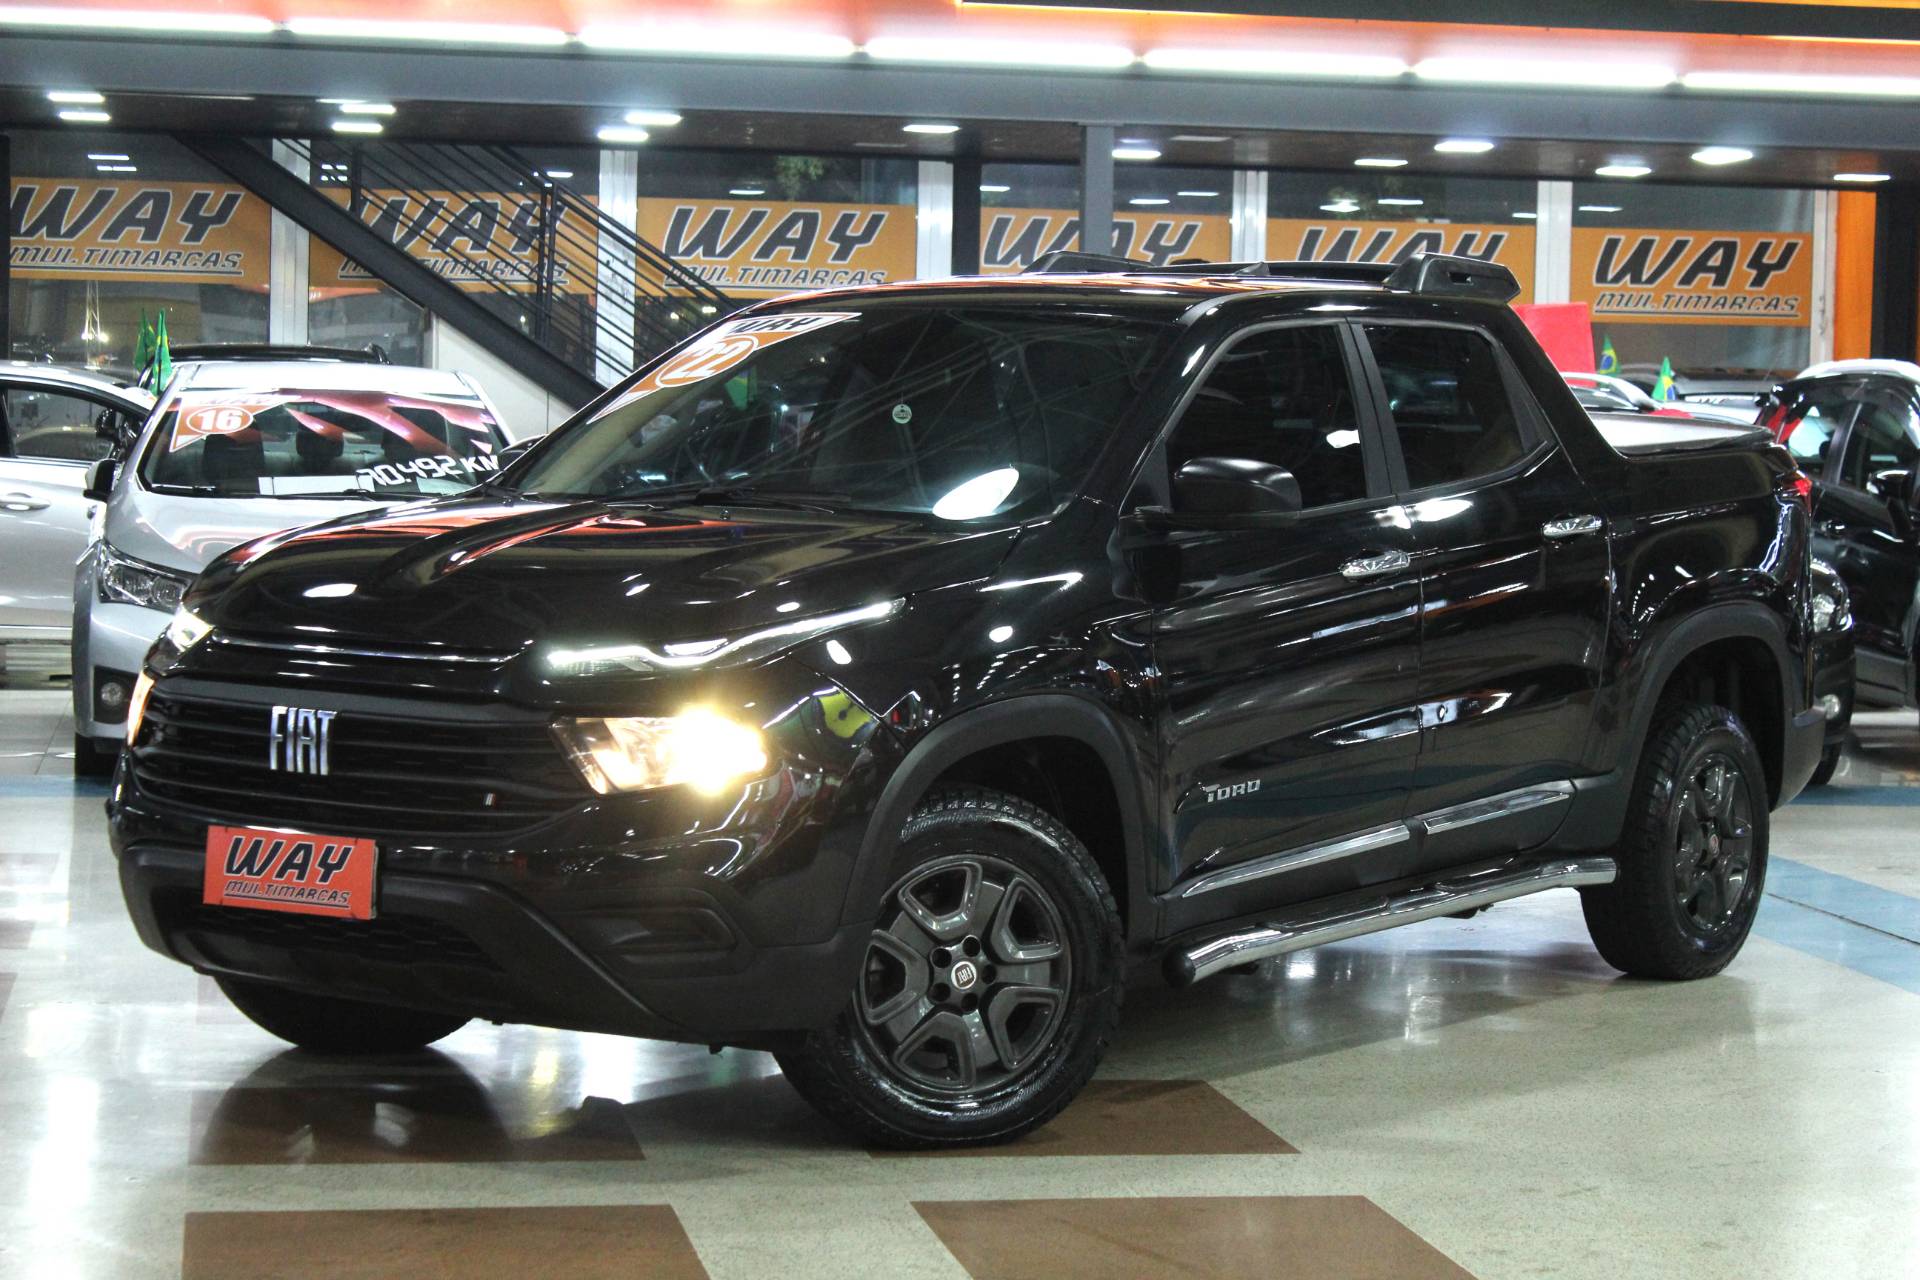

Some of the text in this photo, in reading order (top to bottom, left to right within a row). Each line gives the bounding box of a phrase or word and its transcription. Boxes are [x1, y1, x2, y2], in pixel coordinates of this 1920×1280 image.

[10, 185, 245, 245] WAY
[662, 206, 889, 264] WAY
[10, 246, 243, 269] MULTIMARCAS
[1593, 235, 1803, 290] WAY
[1596, 292, 1799, 312] MULTIMARCAS
[198, 408, 244, 431] 16
[269, 705, 338, 776] FIAT
[1203, 779, 1261, 803] TORO
[223, 835, 355, 886] WAY
[224, 880, 351, 905] MULTIMARCAS
